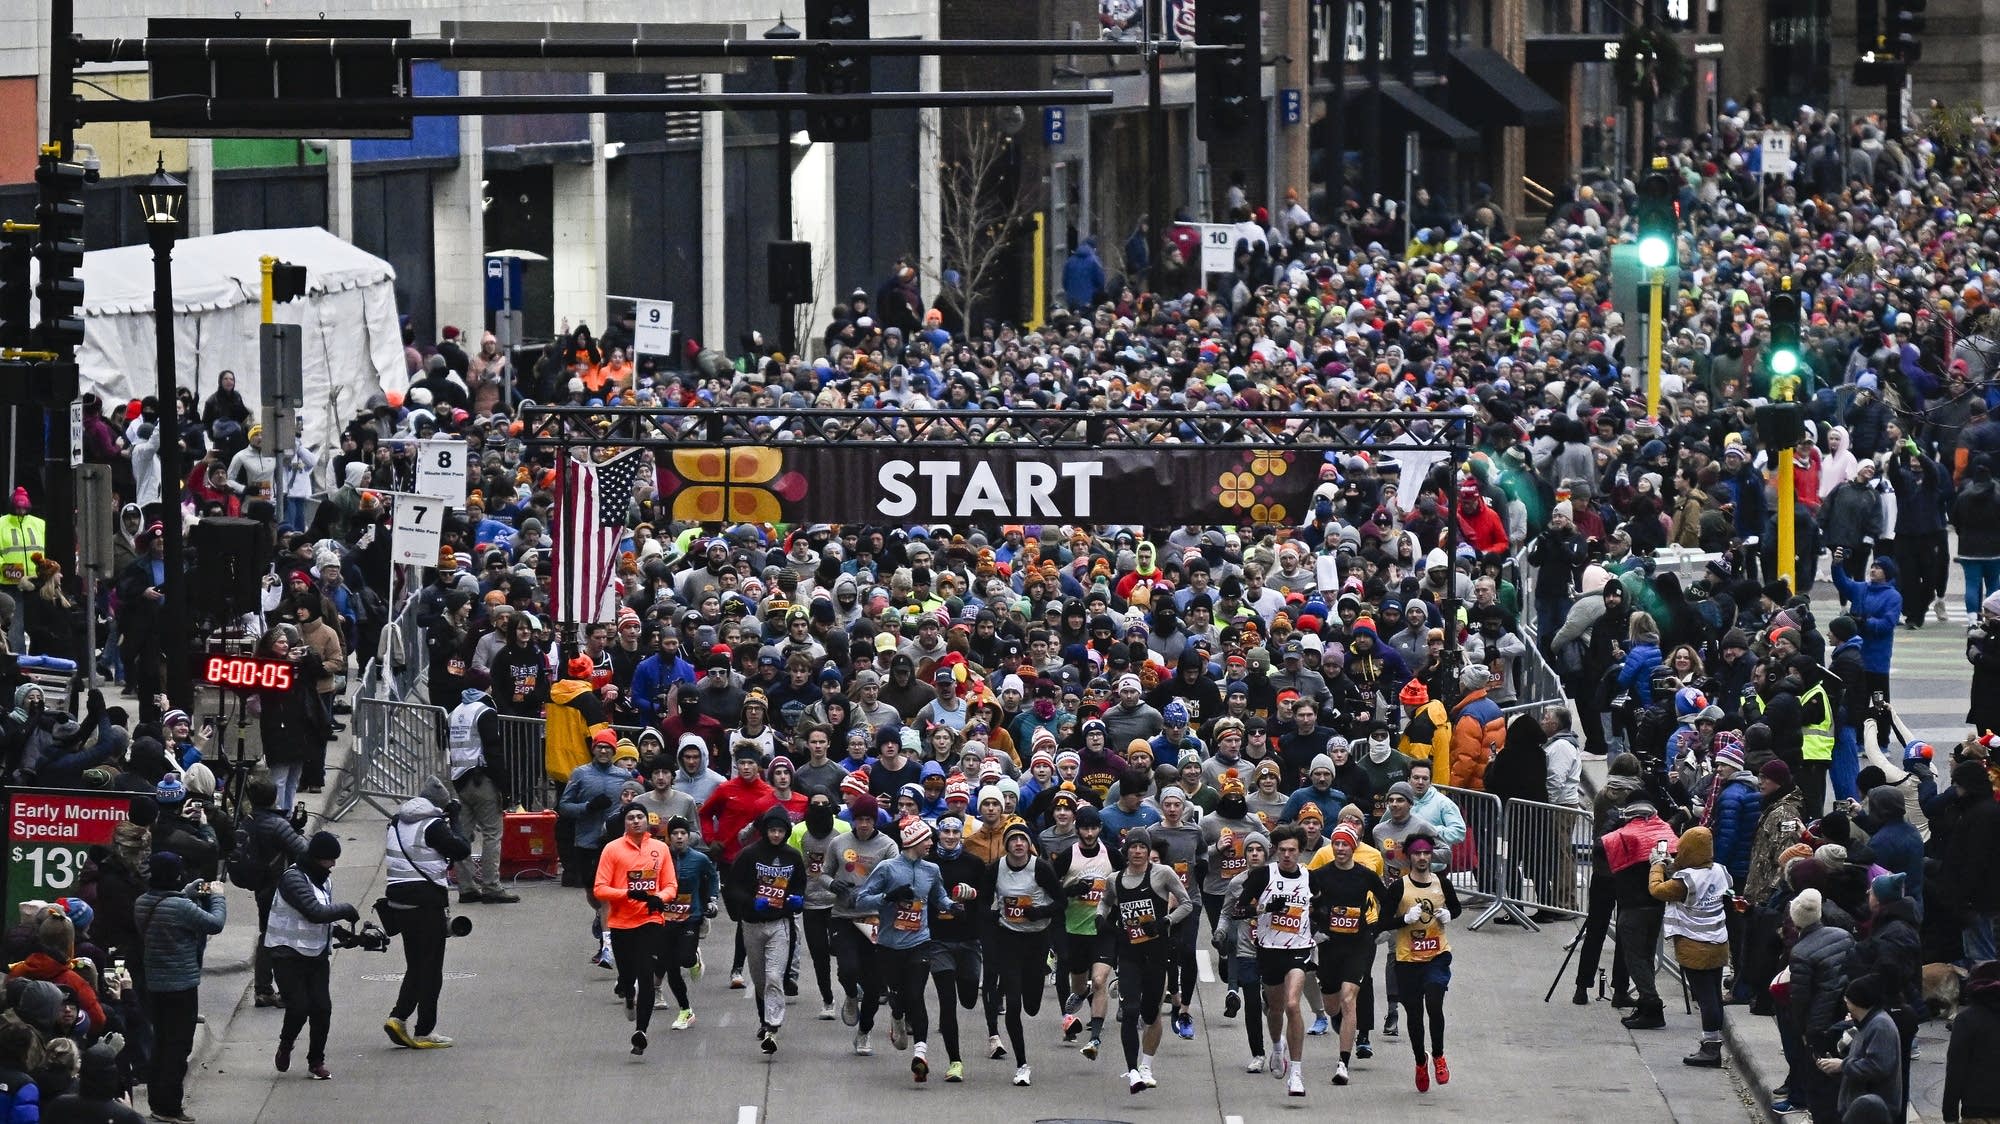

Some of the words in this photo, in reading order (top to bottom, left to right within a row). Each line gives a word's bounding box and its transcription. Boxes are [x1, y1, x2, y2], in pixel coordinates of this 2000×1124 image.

[1209, 232, 1227, 244] 10
[650, 309, 660, 323] 9
[438, 451, 452, 468] 8
[876, 461, 1103, 517] START
[413, 506, 427, 524] 7
[15, 803, 60, 822] Early
[13, 821, 78, 839] Special
[1221, 858, 1247, 869] 3852
[628, 881, 656, 891] 3028
[758, 885, 785, 898] 3279
[664, 903, 690, 913] 3027
[1121, 900, 1151, 912] SQUARE
[1122, 908, 1153, 920] STATE
[1272, 915, 1300, 927] 3600
[1331, 917, 1359, 928] 3057
[1414, 939, 1437, 951] 2112
